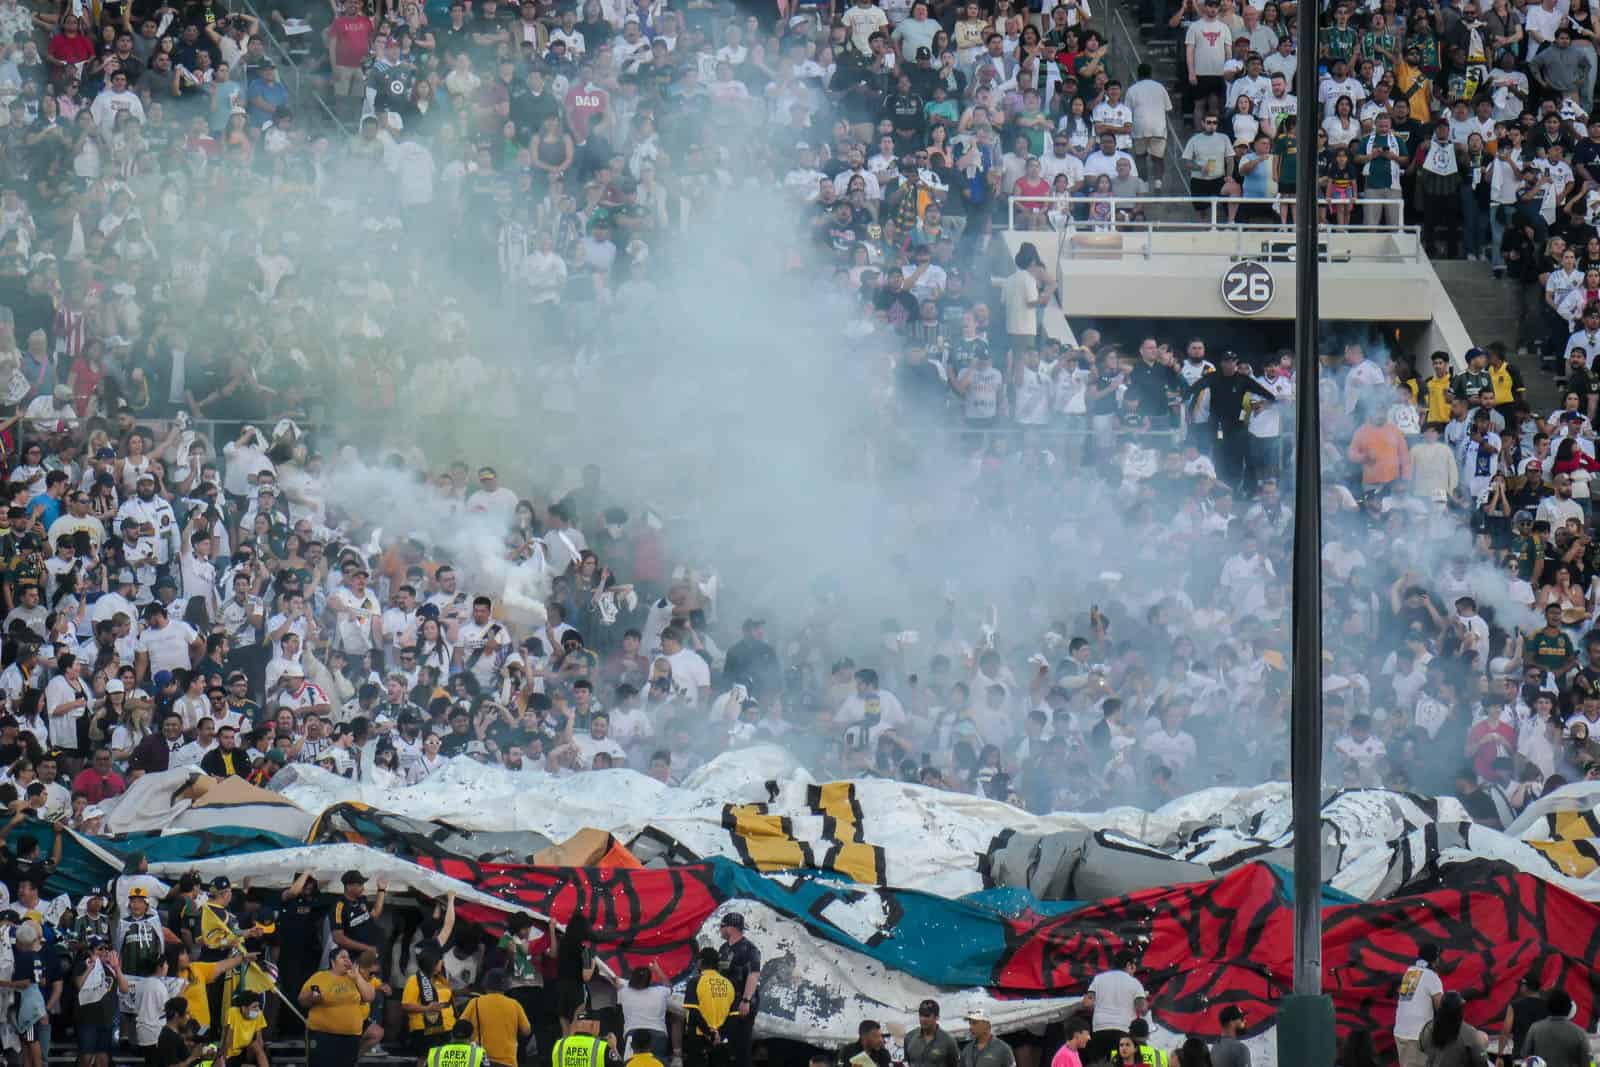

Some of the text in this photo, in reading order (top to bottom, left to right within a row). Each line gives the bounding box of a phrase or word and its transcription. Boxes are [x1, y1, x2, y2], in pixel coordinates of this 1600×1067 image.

[575, 95, 599, 107] DAD
[1227, 273, 1270, 302] 26
[443, 1050, 467, 1059] APEX
[566, 1047, 589, 1057] APEX
[564, 1058, 589, 1067] SECURITY
